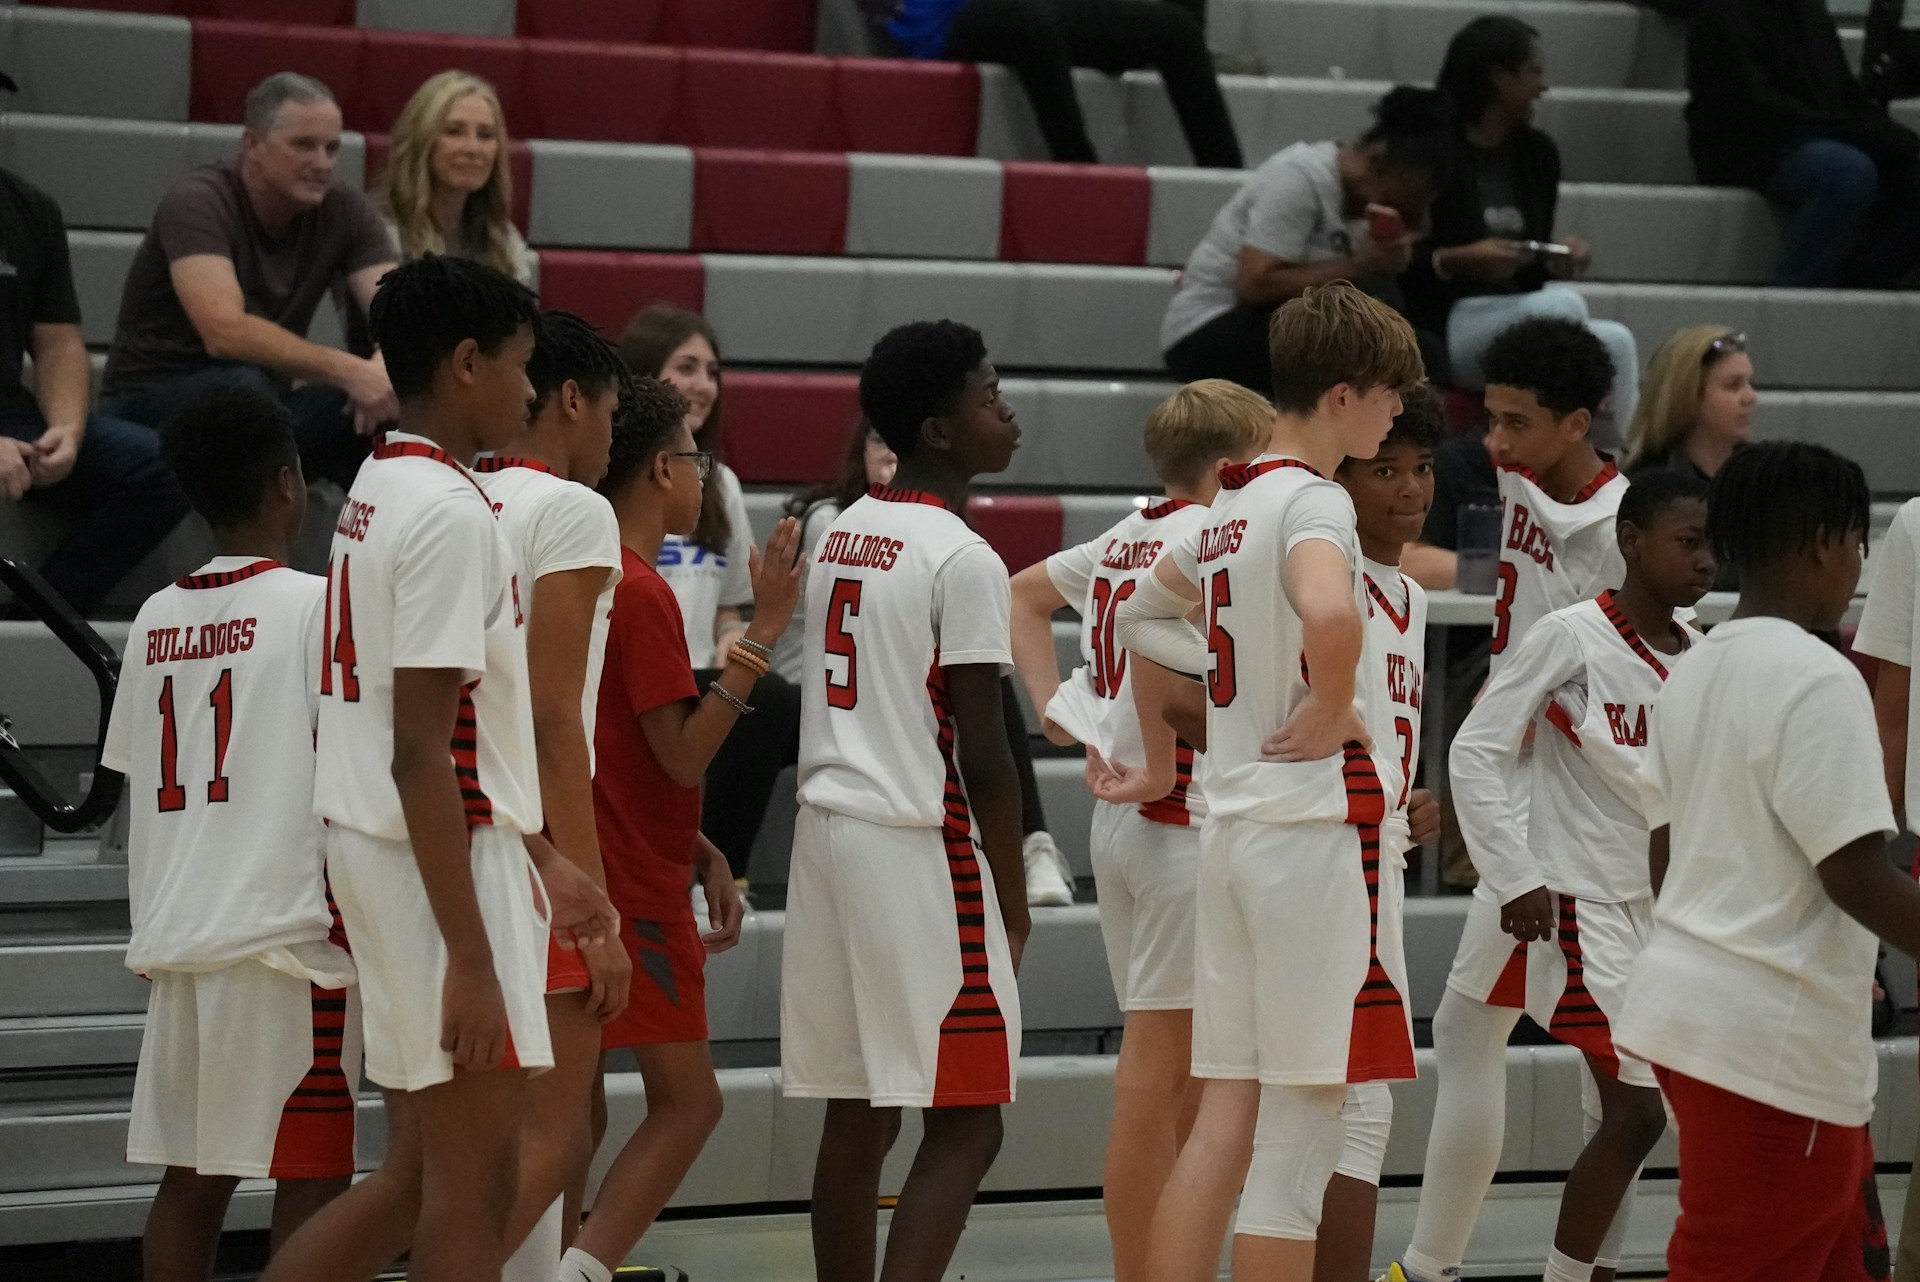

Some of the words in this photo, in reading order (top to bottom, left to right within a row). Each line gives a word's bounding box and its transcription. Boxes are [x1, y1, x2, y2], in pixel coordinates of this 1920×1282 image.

[819, 532, 904, 571] BULLDOGS
[147, 618, 257, 665] BULLDOGS
[824, 577, 863, 711] 5
[1089, 576, 1137, 700] 30
[157, 667, 234, 814] 11
[1603, 702, 1654, 747] BLA
